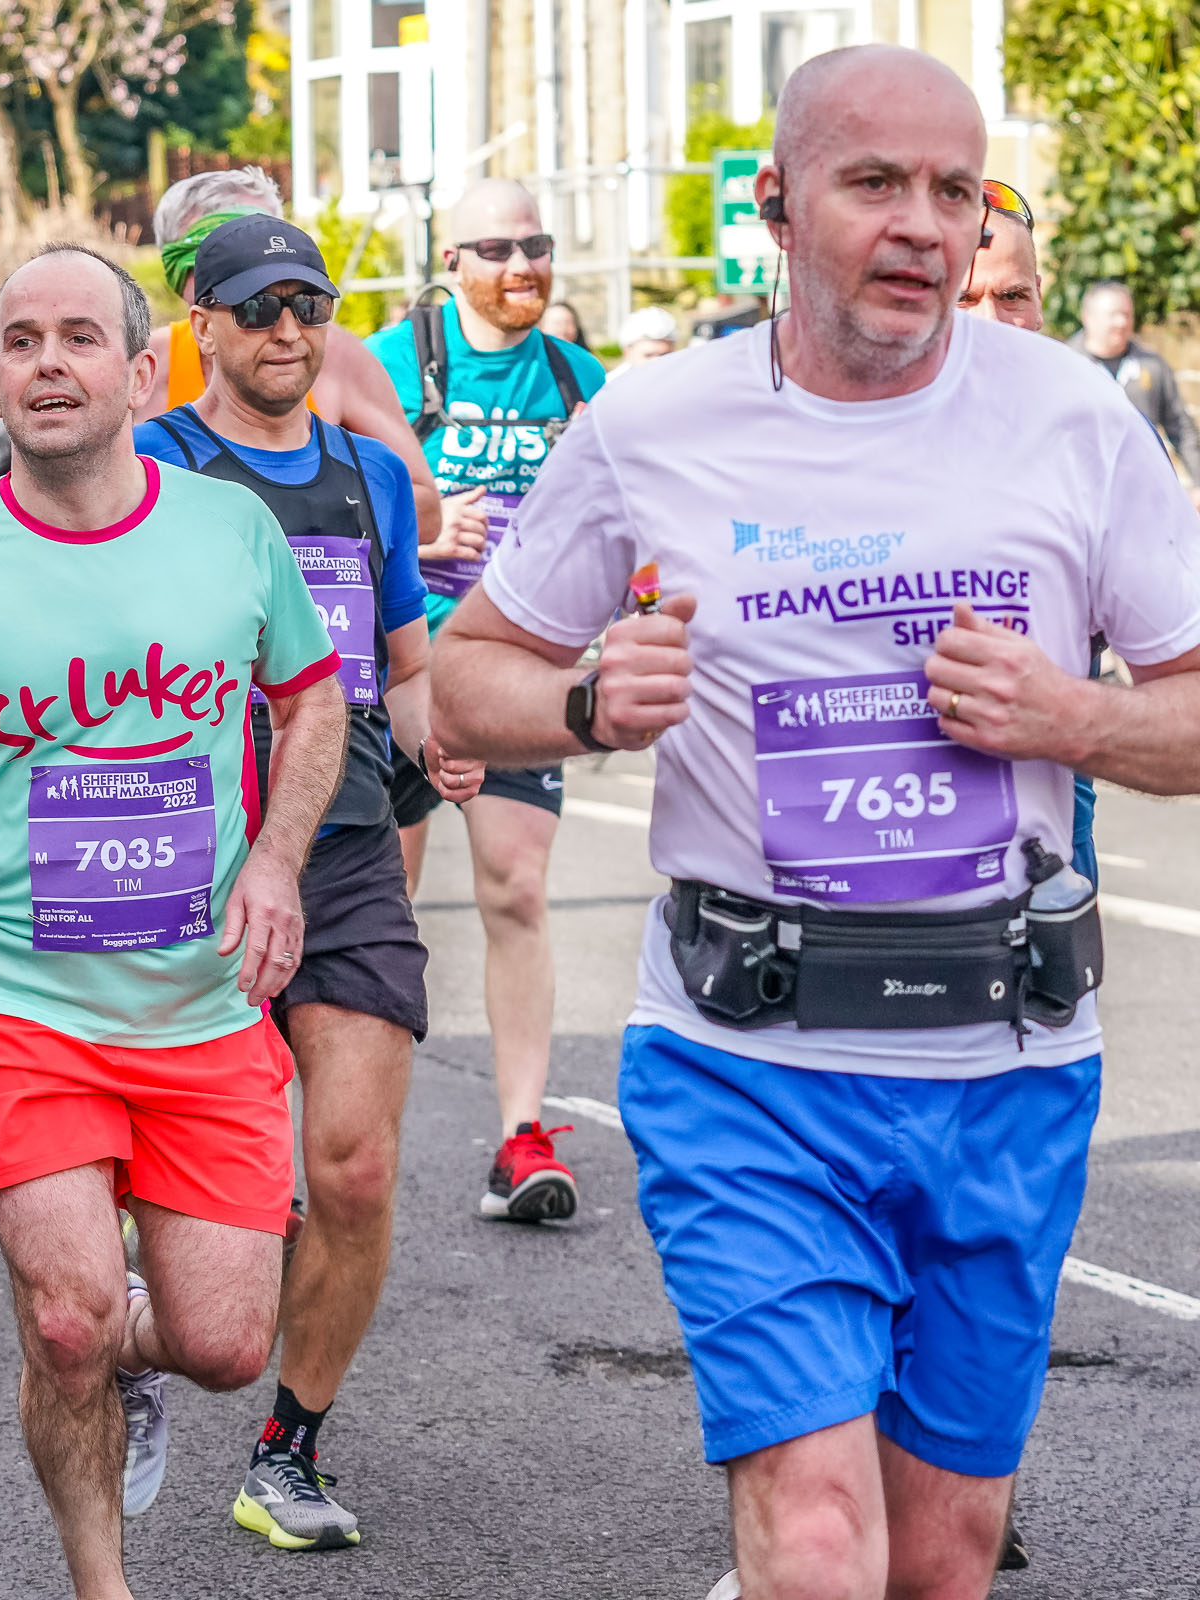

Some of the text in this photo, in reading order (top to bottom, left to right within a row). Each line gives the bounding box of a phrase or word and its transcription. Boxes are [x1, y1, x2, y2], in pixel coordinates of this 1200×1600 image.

[438, 457, 464, 476] for
[519, 464, 541, 477] bo
[766, 526, 806, 544] THE
[292, 549, 323, 558] FFIELD
[754, 532, 905, 562] TECHNOLOGY
[302, 559, 360, 569] MARATHON
[813, 551, 891, 573] GROUP
[336, 571, 362, 582] 2022
[68, 642, 238, 728] Luke's
[828, 686, 914, 705] SHEFFIELD
[828, 701, 939, 723] HALF MARA
[83, 773, 147, 786] SHEFFIELD
[83, 779, 196, 799] HALF MARATHON
[163, 792, 197, 809] 2022
[821, 771, 957, 822] 7635
[766, 798, 781, 817] L
[874, 828, 915, 849] TIM
[35, 852, 48, 865] M
[75, 835, 176, 872] 7035
[113, 878, 142, 893] TIM
[828, 880, 851, 893] ALL
[39, 914, 94, 923] RUN FOR ALL
[179, 919, 208, 938] 7035
[103, 934, 157, 948] Baggage label
